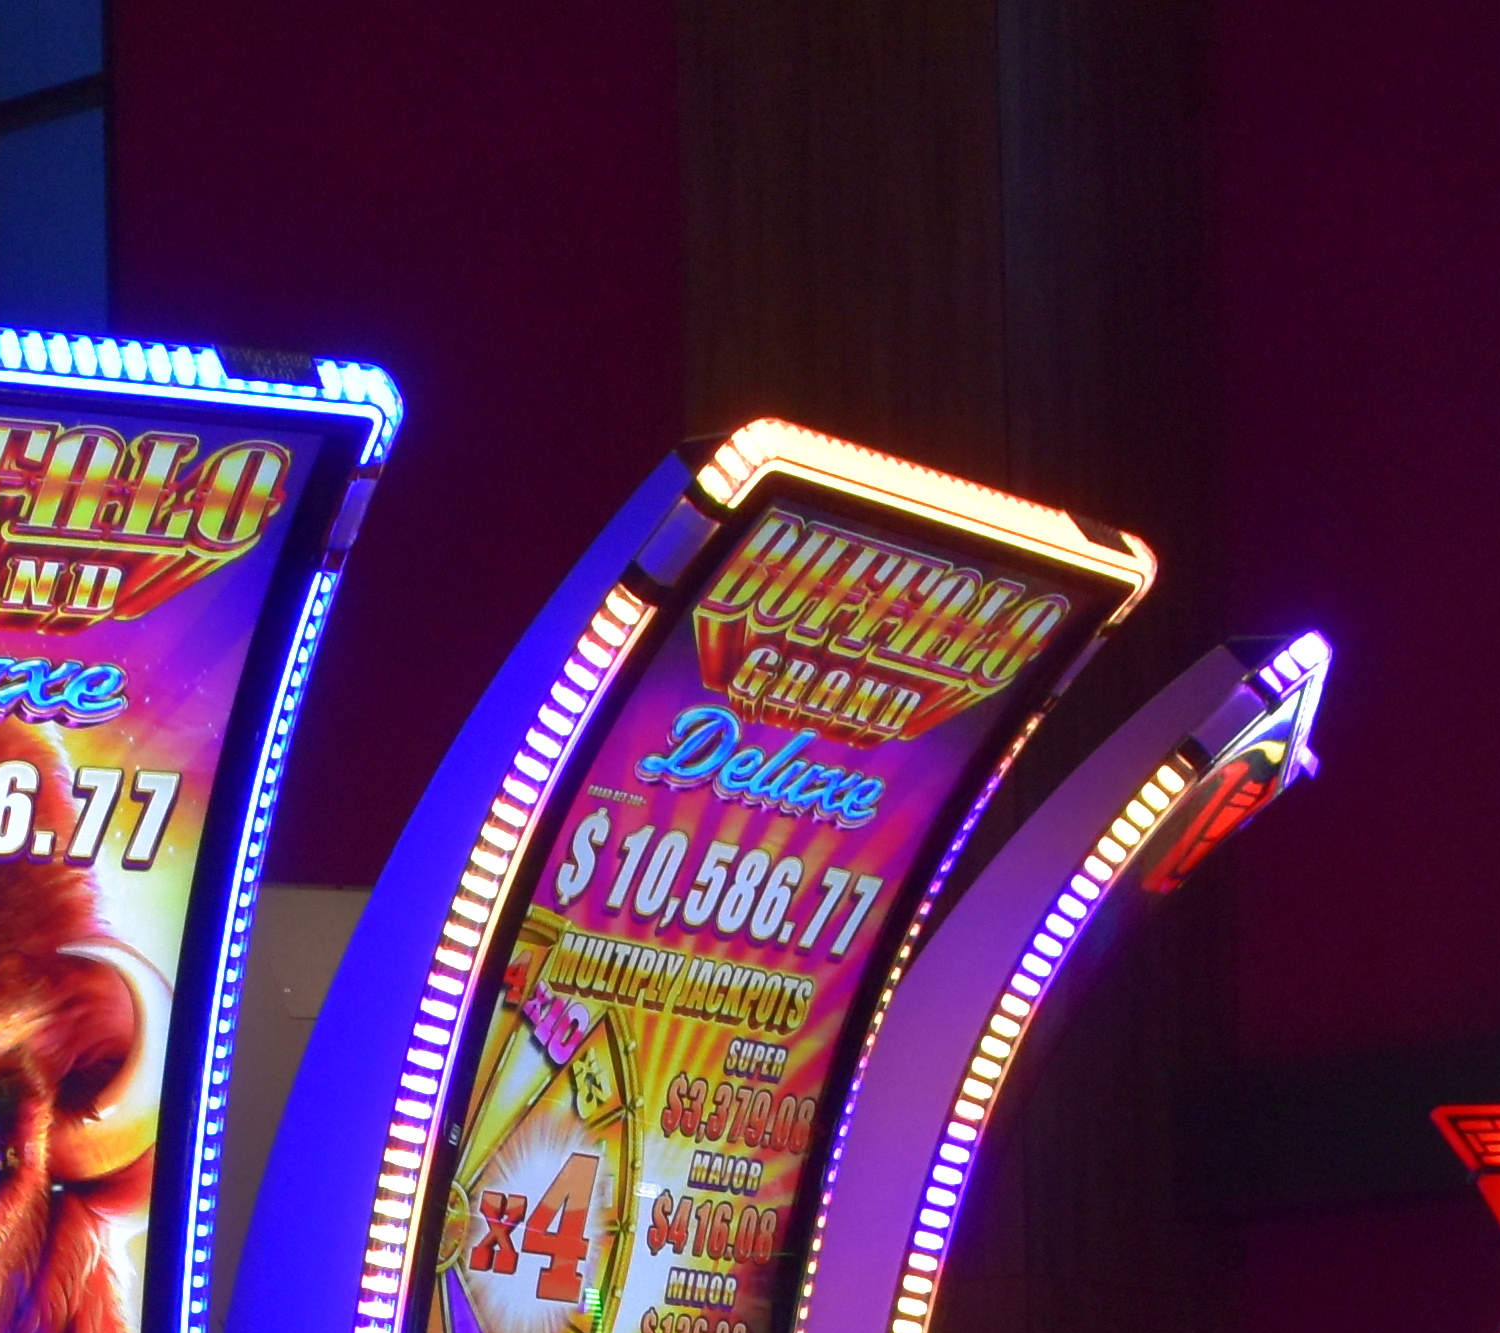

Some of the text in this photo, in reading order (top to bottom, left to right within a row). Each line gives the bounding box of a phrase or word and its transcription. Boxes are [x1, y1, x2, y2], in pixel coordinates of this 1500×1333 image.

[706, 512, 1071, 684] BUFFALO
[731, 645, 921, 734] GRAND
[636, 704, 887, 828] Deluxe
[549, 933, 813, 1032] MULTIPLY JACKPOTS
[726, 1038, 787, 1077] SUPER
[661, 1074, 815, 1153] $3,379.08
[689, 1154, 763, 1192] MAJOR
[647, 1195, 779, 1264] $416.08
[666, 1270, 738, 1305] MINOR
